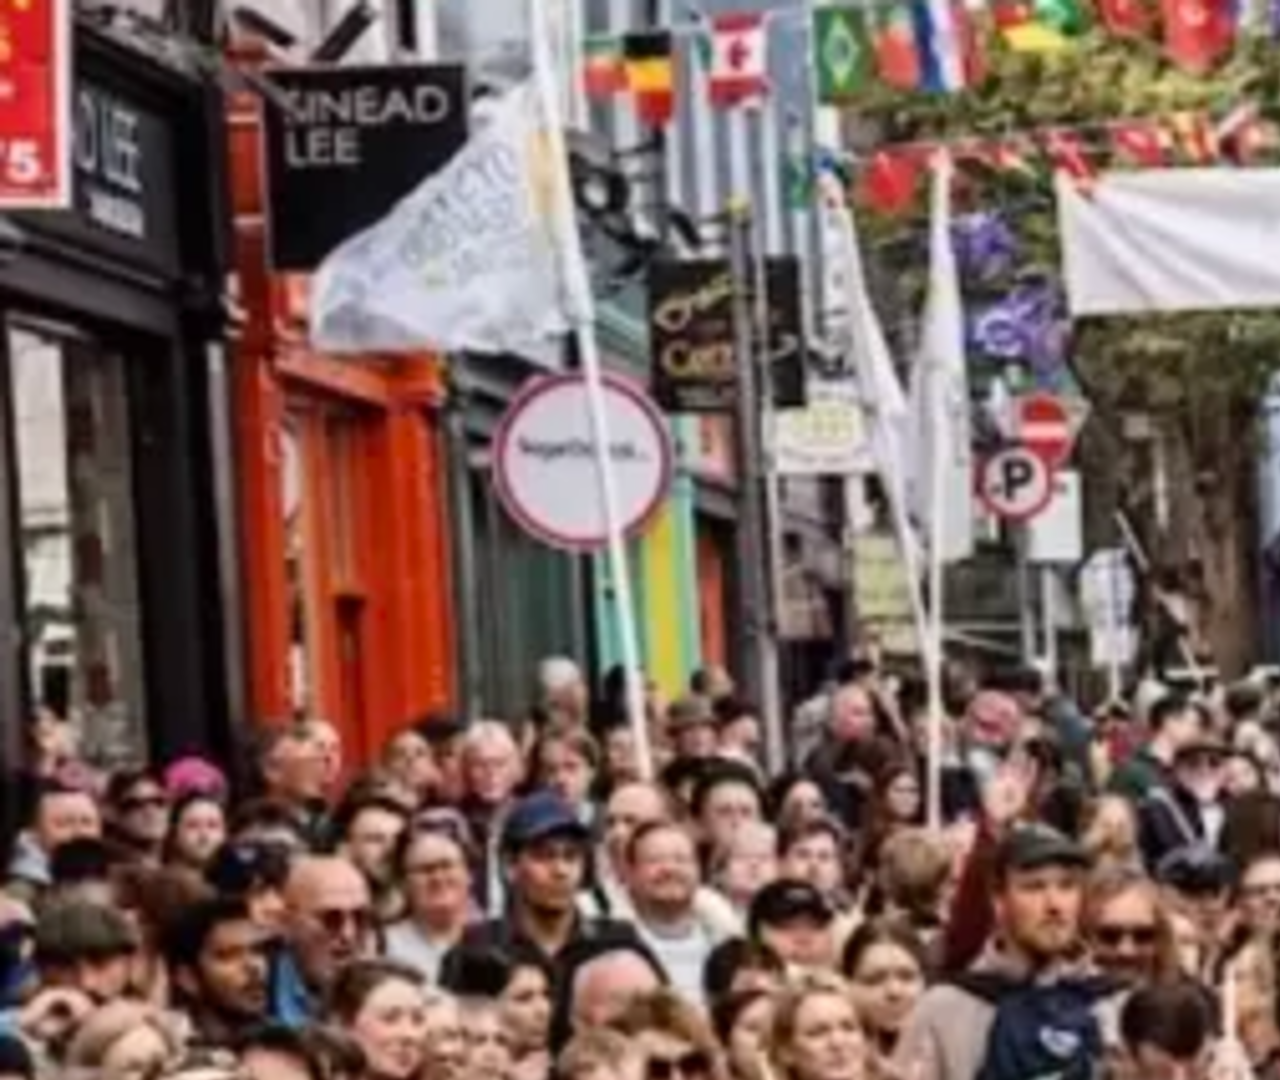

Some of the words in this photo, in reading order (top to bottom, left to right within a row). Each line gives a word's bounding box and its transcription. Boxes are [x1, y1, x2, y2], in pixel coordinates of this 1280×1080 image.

[284, 85, 449, 124] SINEAD
[285, 128, 361, 167] LEE
[1002, 459, 1034, 502] P
